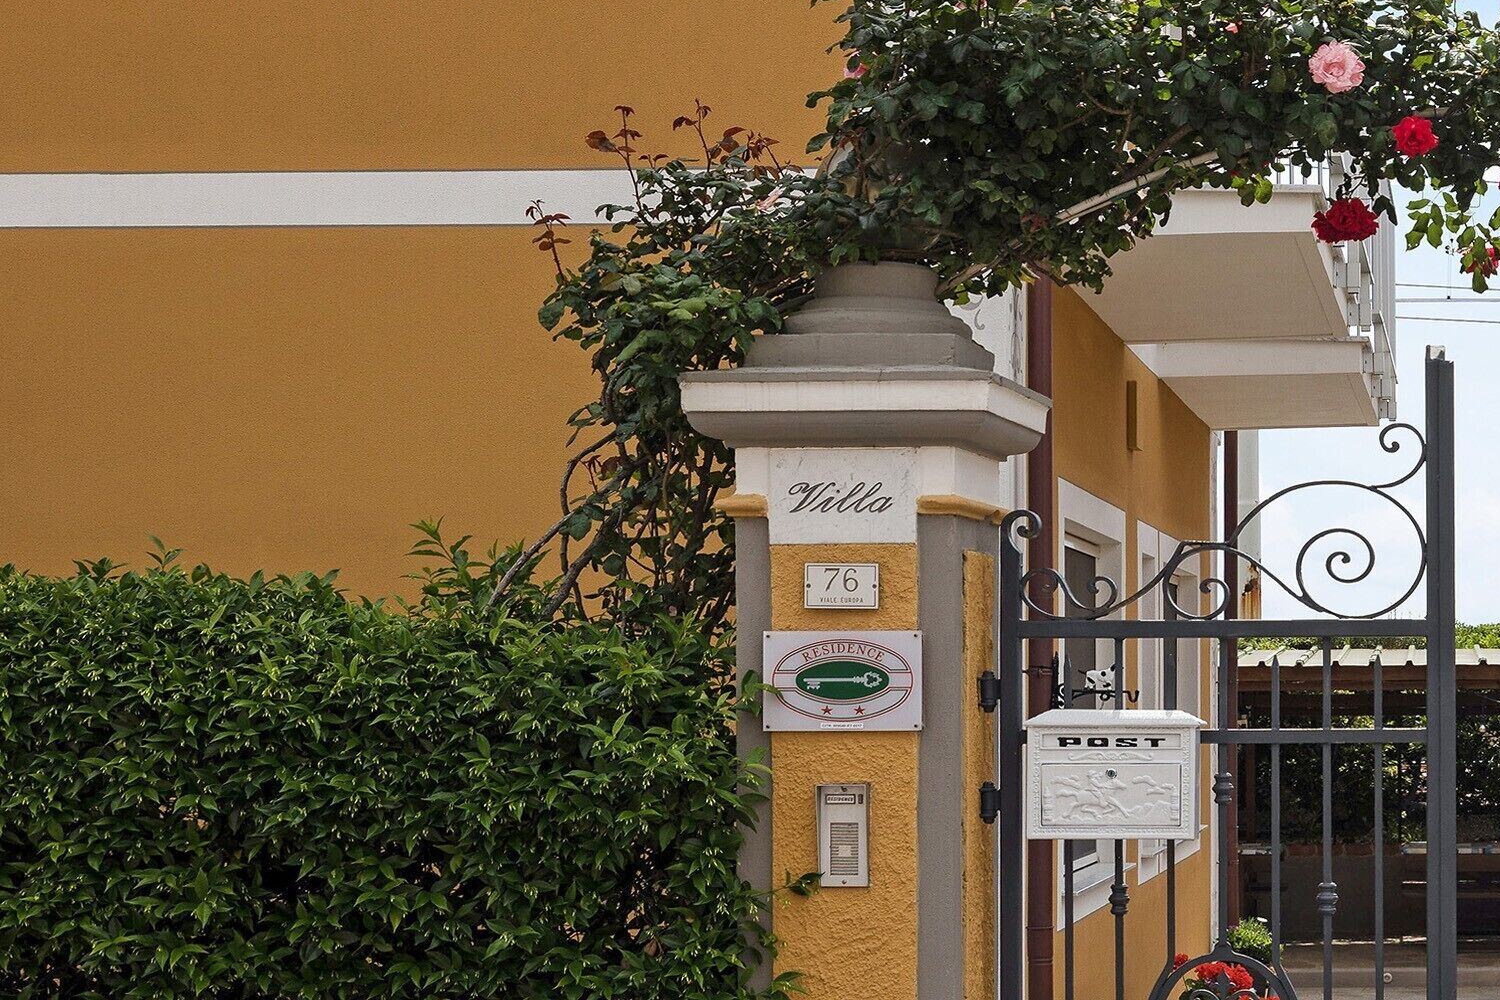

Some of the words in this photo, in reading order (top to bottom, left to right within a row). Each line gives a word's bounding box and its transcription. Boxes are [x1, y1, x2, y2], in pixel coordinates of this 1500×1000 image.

[788, 481, 893, 513] Villa
[823, 567, 859, 593] 76
[801, 642, 885, 663] RESIDENCE
[1057, 737, 1166, 748] POST
